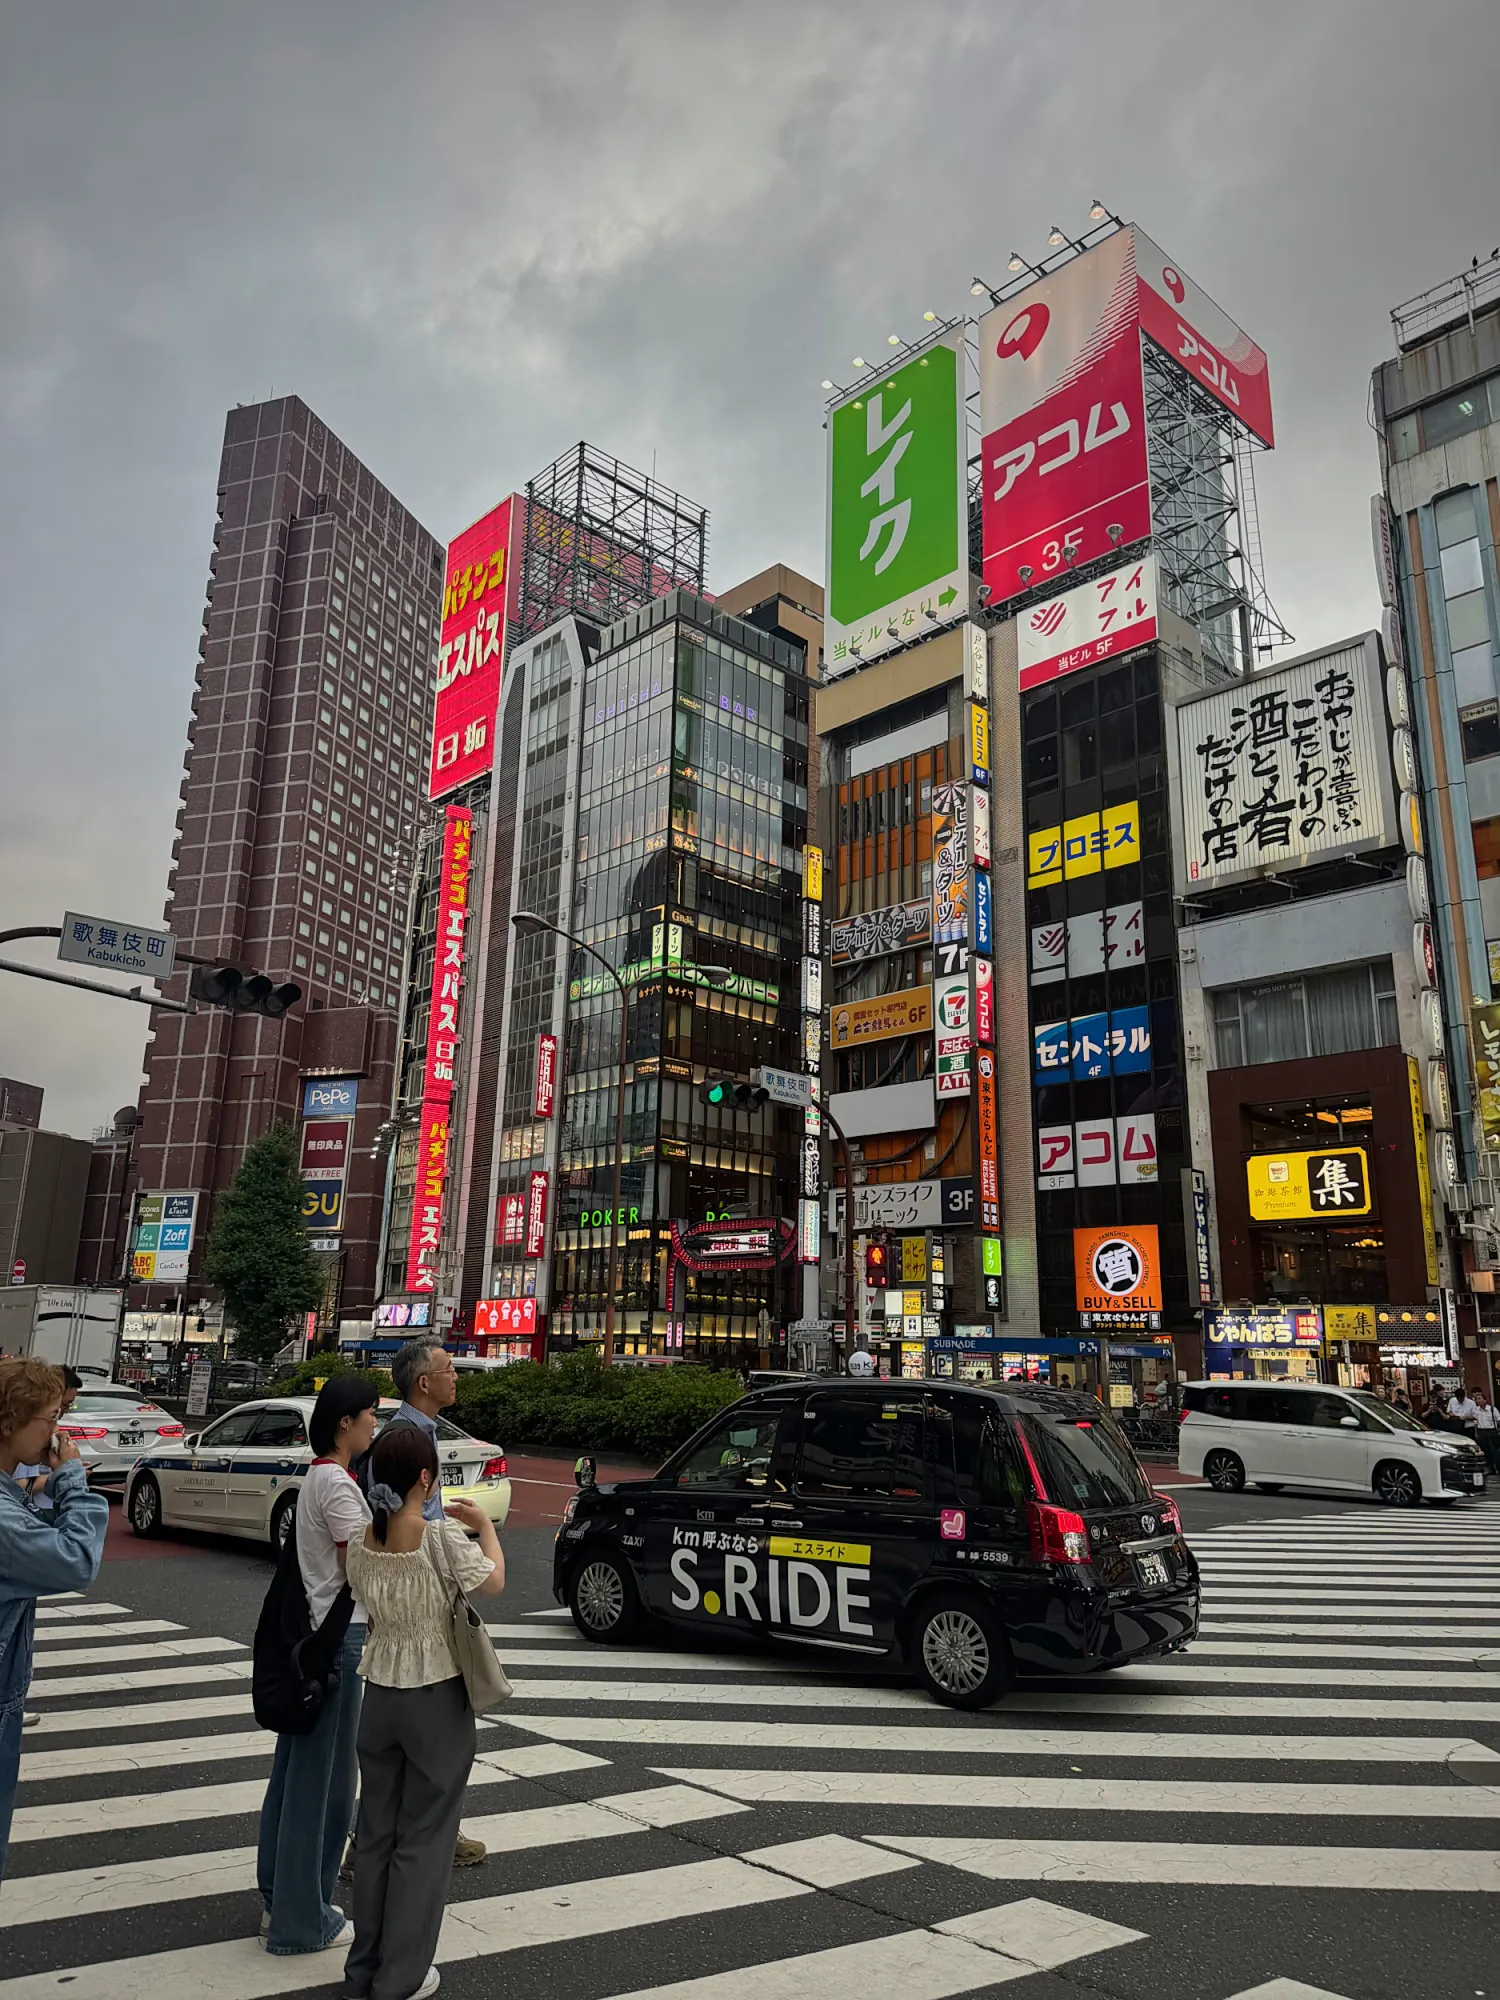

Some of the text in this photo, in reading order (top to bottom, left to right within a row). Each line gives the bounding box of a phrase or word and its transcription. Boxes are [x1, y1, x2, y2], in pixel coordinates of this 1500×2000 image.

[1177, 322, 1240, 407] アコム
[993, 400, 1131, 502] アコム
[860, 393, 914, 577] レイク
[1041, 527, 1084, 571] 3F
[443, 547, 505, 621] パチンコ
[437, 607, 500, 693] エスパス
[1058, 638, 1113, 672] 当ビル 5F
[596, 682, 661, 724] SHISHA
[719, 695, 757, 721] BAR
[976, 712, 985, 763] プロミス
[716, 760, 782, 798] POKER
[976, 769, 986, 779] 6F
[1291, 699, 1328, 837] こだわりの
[1196, 735, 1245, 867] だけの店
[1038, 822, 1136, 869] プロミス
[450, 820, 470, 904] パチンコ
[72, 921, 167, 958] 歌舞伎町
[671, 926, 679, 953] ダーツ
[87, 947, 146, 969] Kabukicho
[437, 910, 464, 1034] エスパス
[908, 1005, 926, 1024] 6F
[979, 990, 989, 1029] アコム
[1037, 1026, 1151, 1067] セントラル
[808, 1061, 819, 1073] 7F
[950, 1057, 964, 1070] 酒
[1088, 1065, 1102, 1077] 4F
[766, 1072, 807, 1093] 歌舞伎町
[774, 1088, 800, 1100] Kabukicho
[311, 1089, 350, 1106] PePe
[307, 1140, 343, 1151] 無印良品
[1041, 1127, 1156, 1170] アコム
[425, 1121, 447, 1196] パチンコ
[321, 1169, 341, 1178] FREE
[1049, 1177, 1065, 1188] 3F
[1312, 1159, 1359, 1206] 集
[301, 1192, 339, 1216] GU
[860, 1185, 933, 1205] メンズライフ
[949, 1189, 973, 1212] 3F
[1264, 1200, 1296, 1210] Premium
[532, 1188, 544, 1252] GAME
[580, 1207, 639, 1228] POKER
[164, 1228, 188, 1242] Zoff
[133, 1256, 152, 1267] ABC
[125, 1323, 143, 1331] PePe
[1208, 1323, 1293, 1343] じゃんぱら
[1352, 1311, 1373, 1336] 集
[933, 1339, 976, 1350] SUBNADE
[793, 1542, 845, 1559] エスライド
[983, 1551, 1009, 1563] 5539
